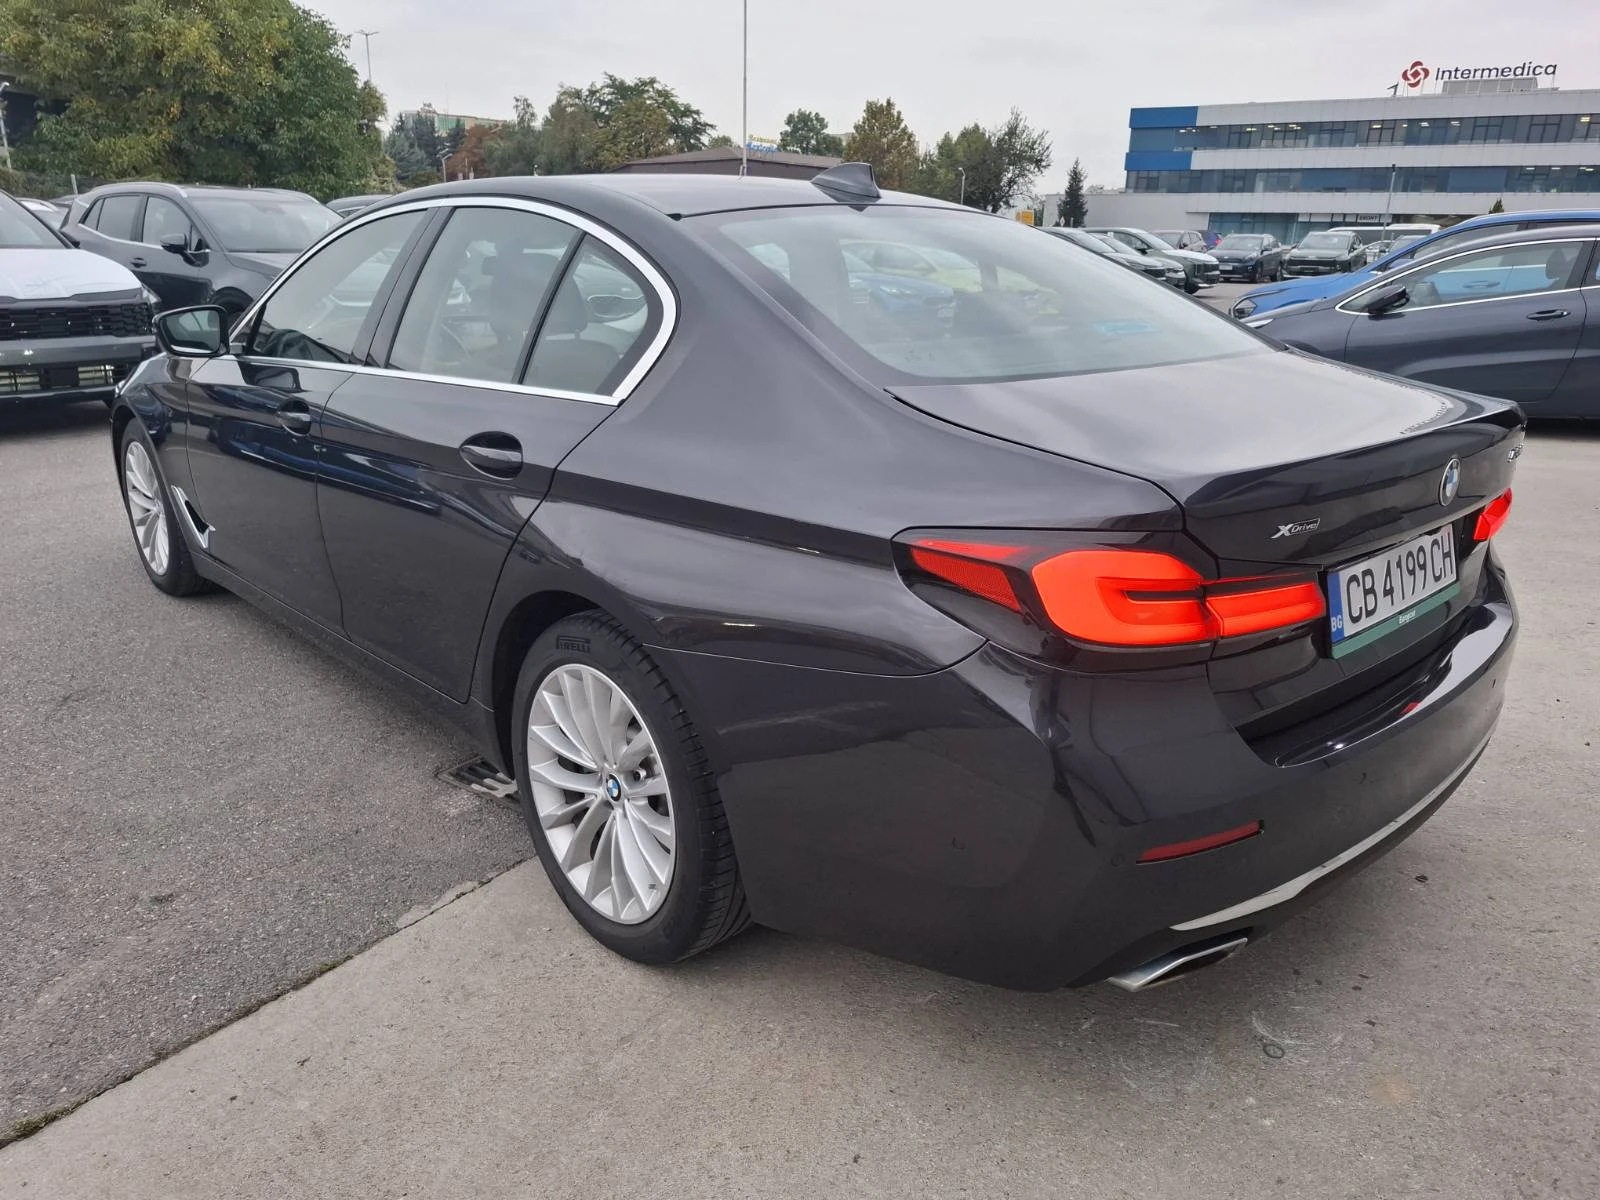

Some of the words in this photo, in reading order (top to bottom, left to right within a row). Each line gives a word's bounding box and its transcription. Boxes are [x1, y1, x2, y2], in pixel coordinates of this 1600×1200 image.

[1435, 61, 1557, 81] Intermedica
[1346, 568, 1378, 624] CB
[1382, 544, 1427, 606] 4199
[1430, 531, 1454, 583] CH
[1331, 614, 1343, 632] BG
